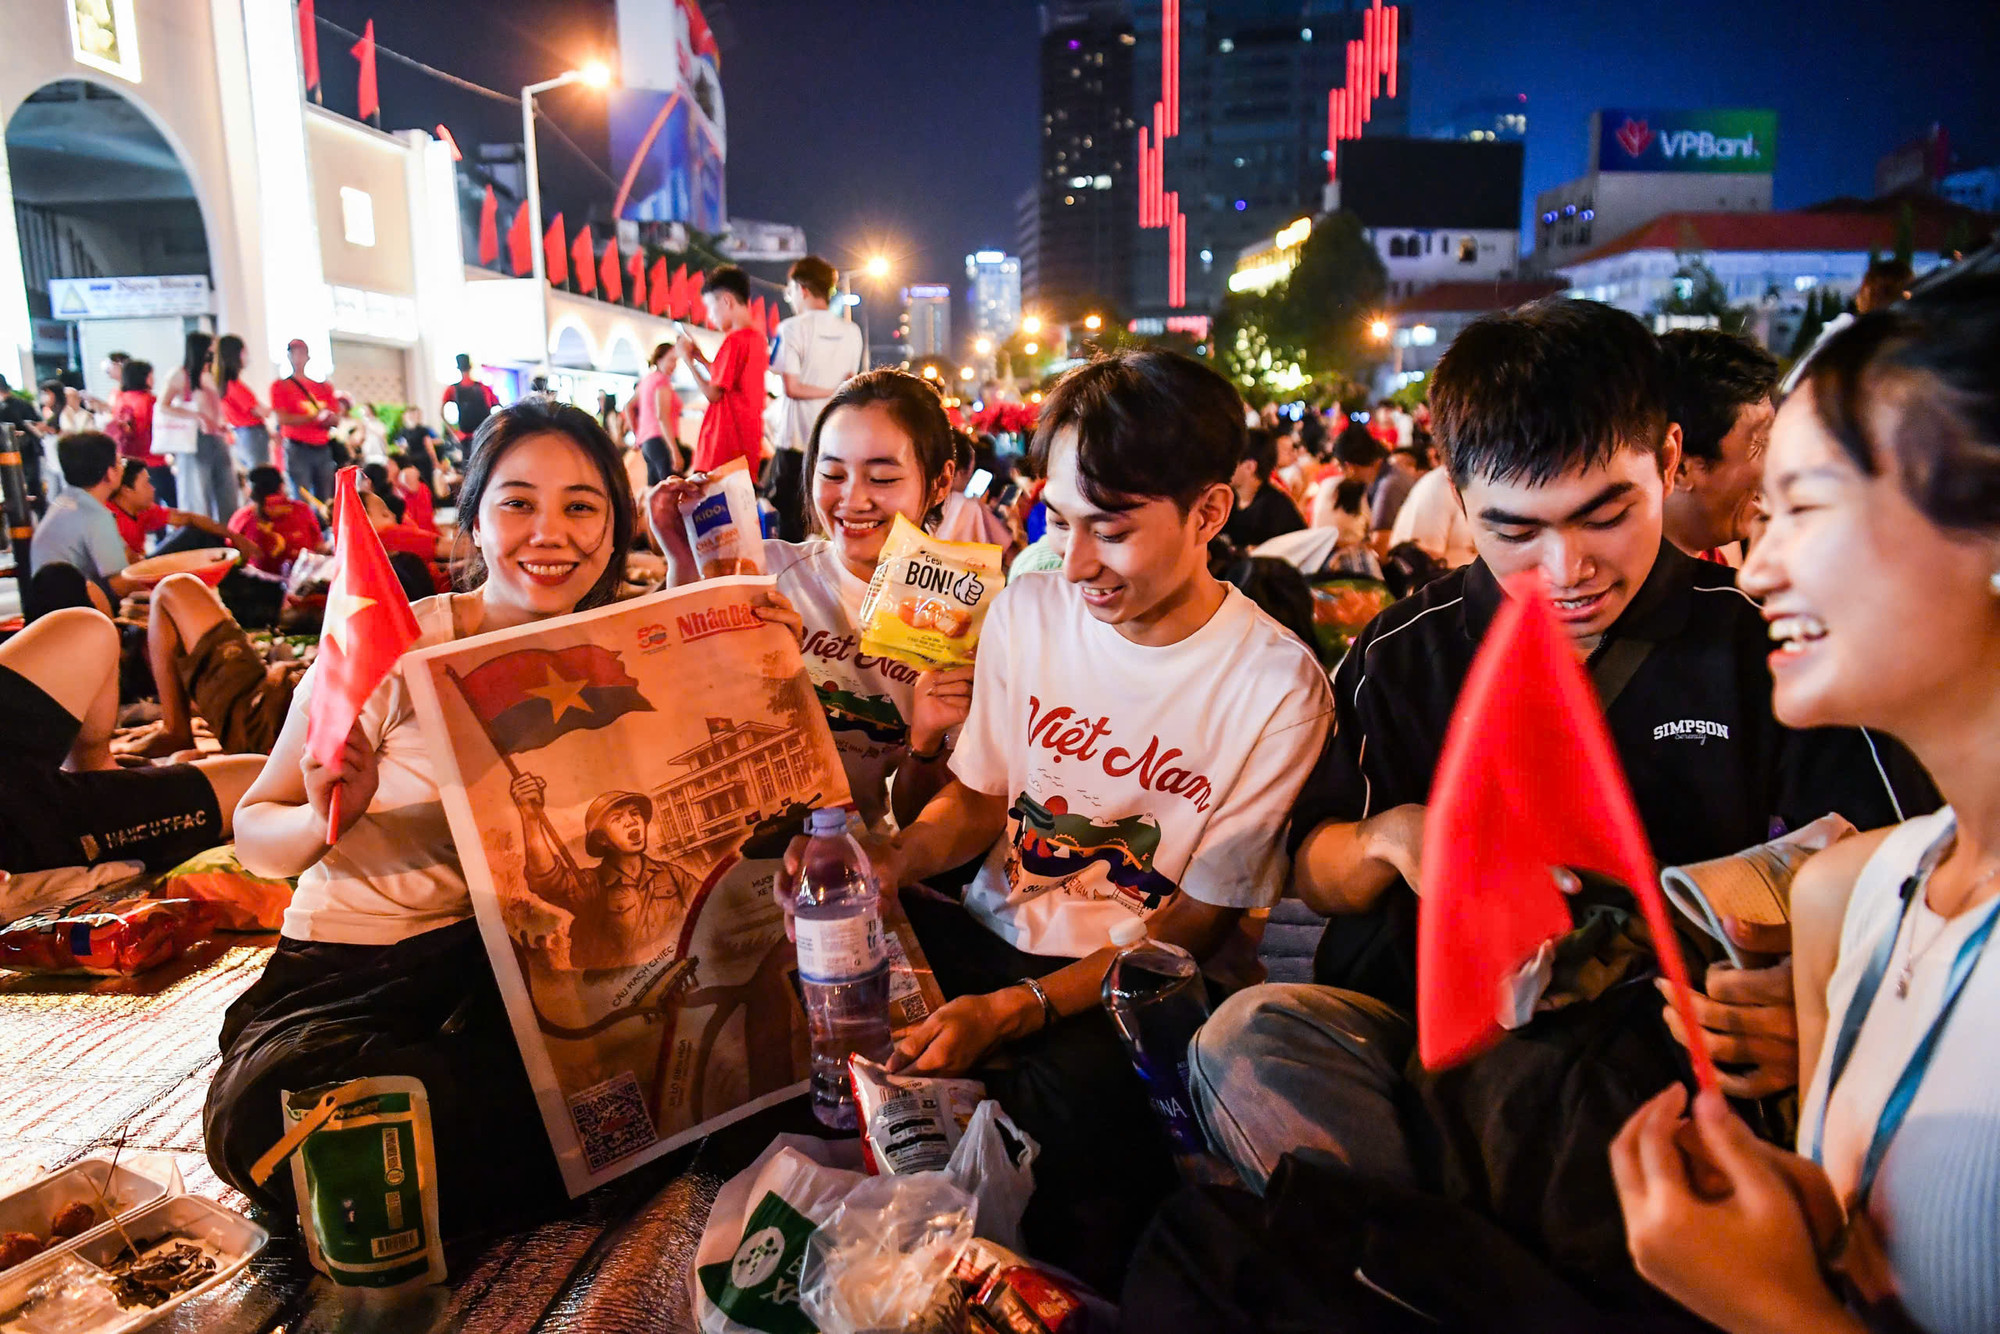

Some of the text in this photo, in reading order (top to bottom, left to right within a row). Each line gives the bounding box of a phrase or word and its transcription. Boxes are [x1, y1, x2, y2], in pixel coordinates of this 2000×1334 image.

[904, 560, 955, 596] BON!
[1653, 719, 1729, 740] SIMPSON
[1028, 695, 1213, 813] Việt Nam
